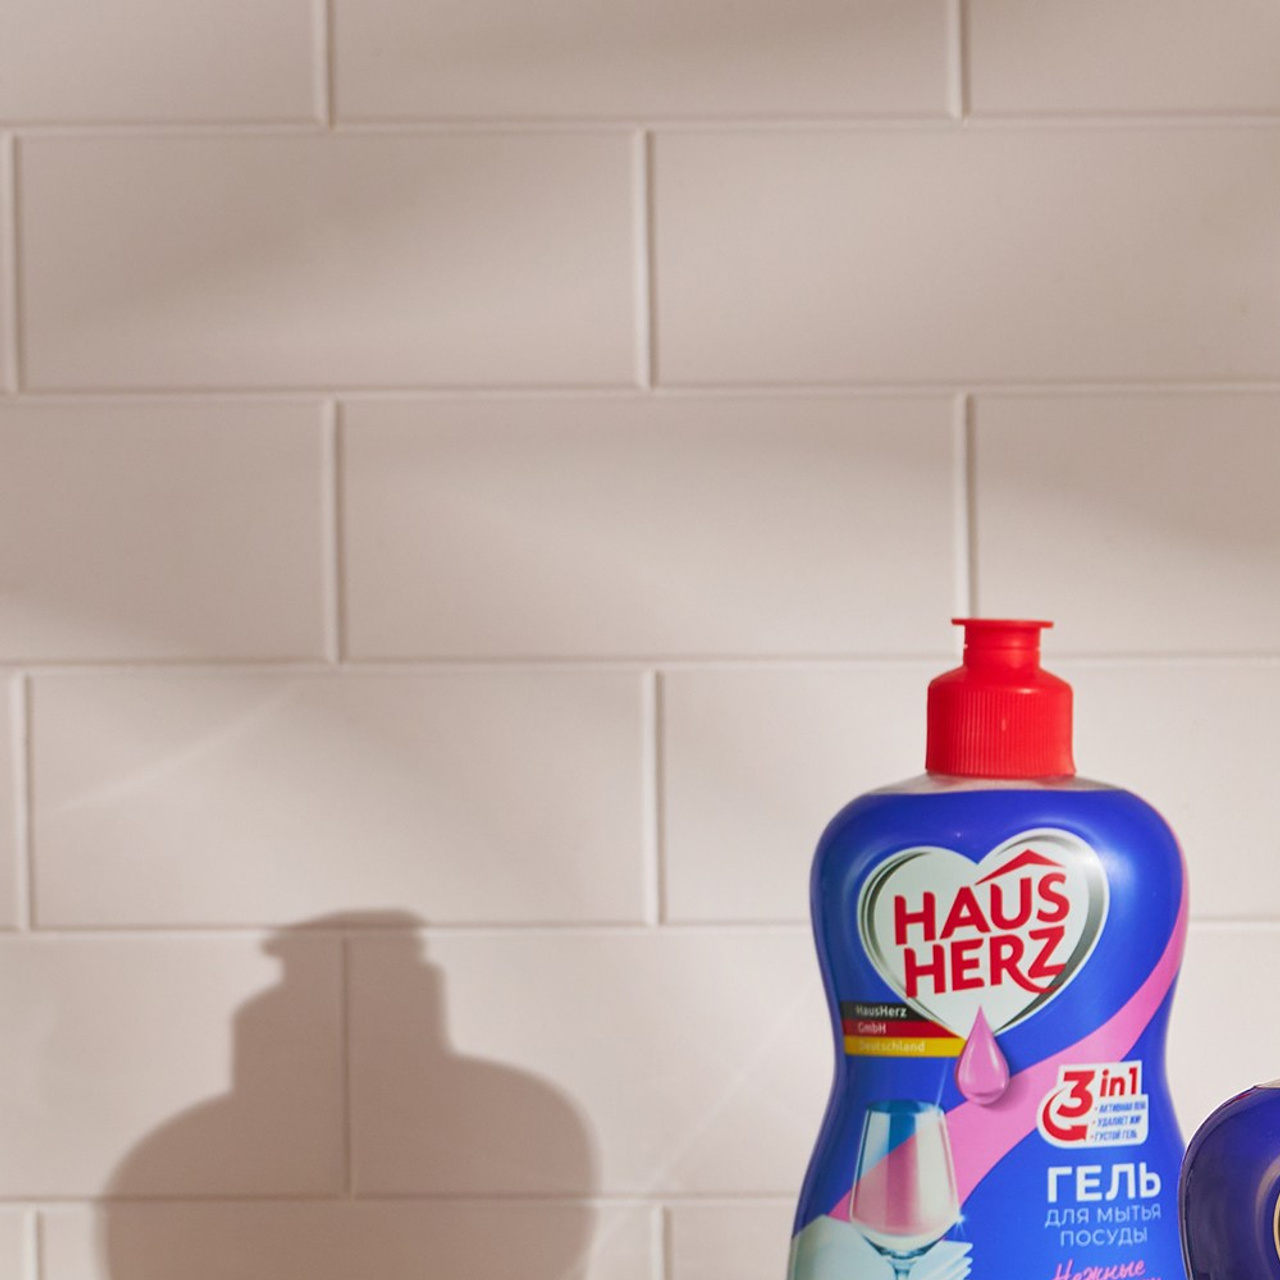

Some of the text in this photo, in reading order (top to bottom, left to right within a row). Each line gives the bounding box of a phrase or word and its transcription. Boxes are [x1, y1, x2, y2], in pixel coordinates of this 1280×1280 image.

[894, 872, 1071, 946] HAUS
[903, 924, 1067, 998] HERZ
[856, 1004, 908, 1019] HausHerz
[858, 1021, 887, 1035] GmbH
[1047, 1162, 1162, 1203] ГЕЛЬ
[1044, 1203, 1162, 1228] ДЛЯ МЫТЬЯ
[1060, 1226, 1148, 1248] ПОСУДЫ
